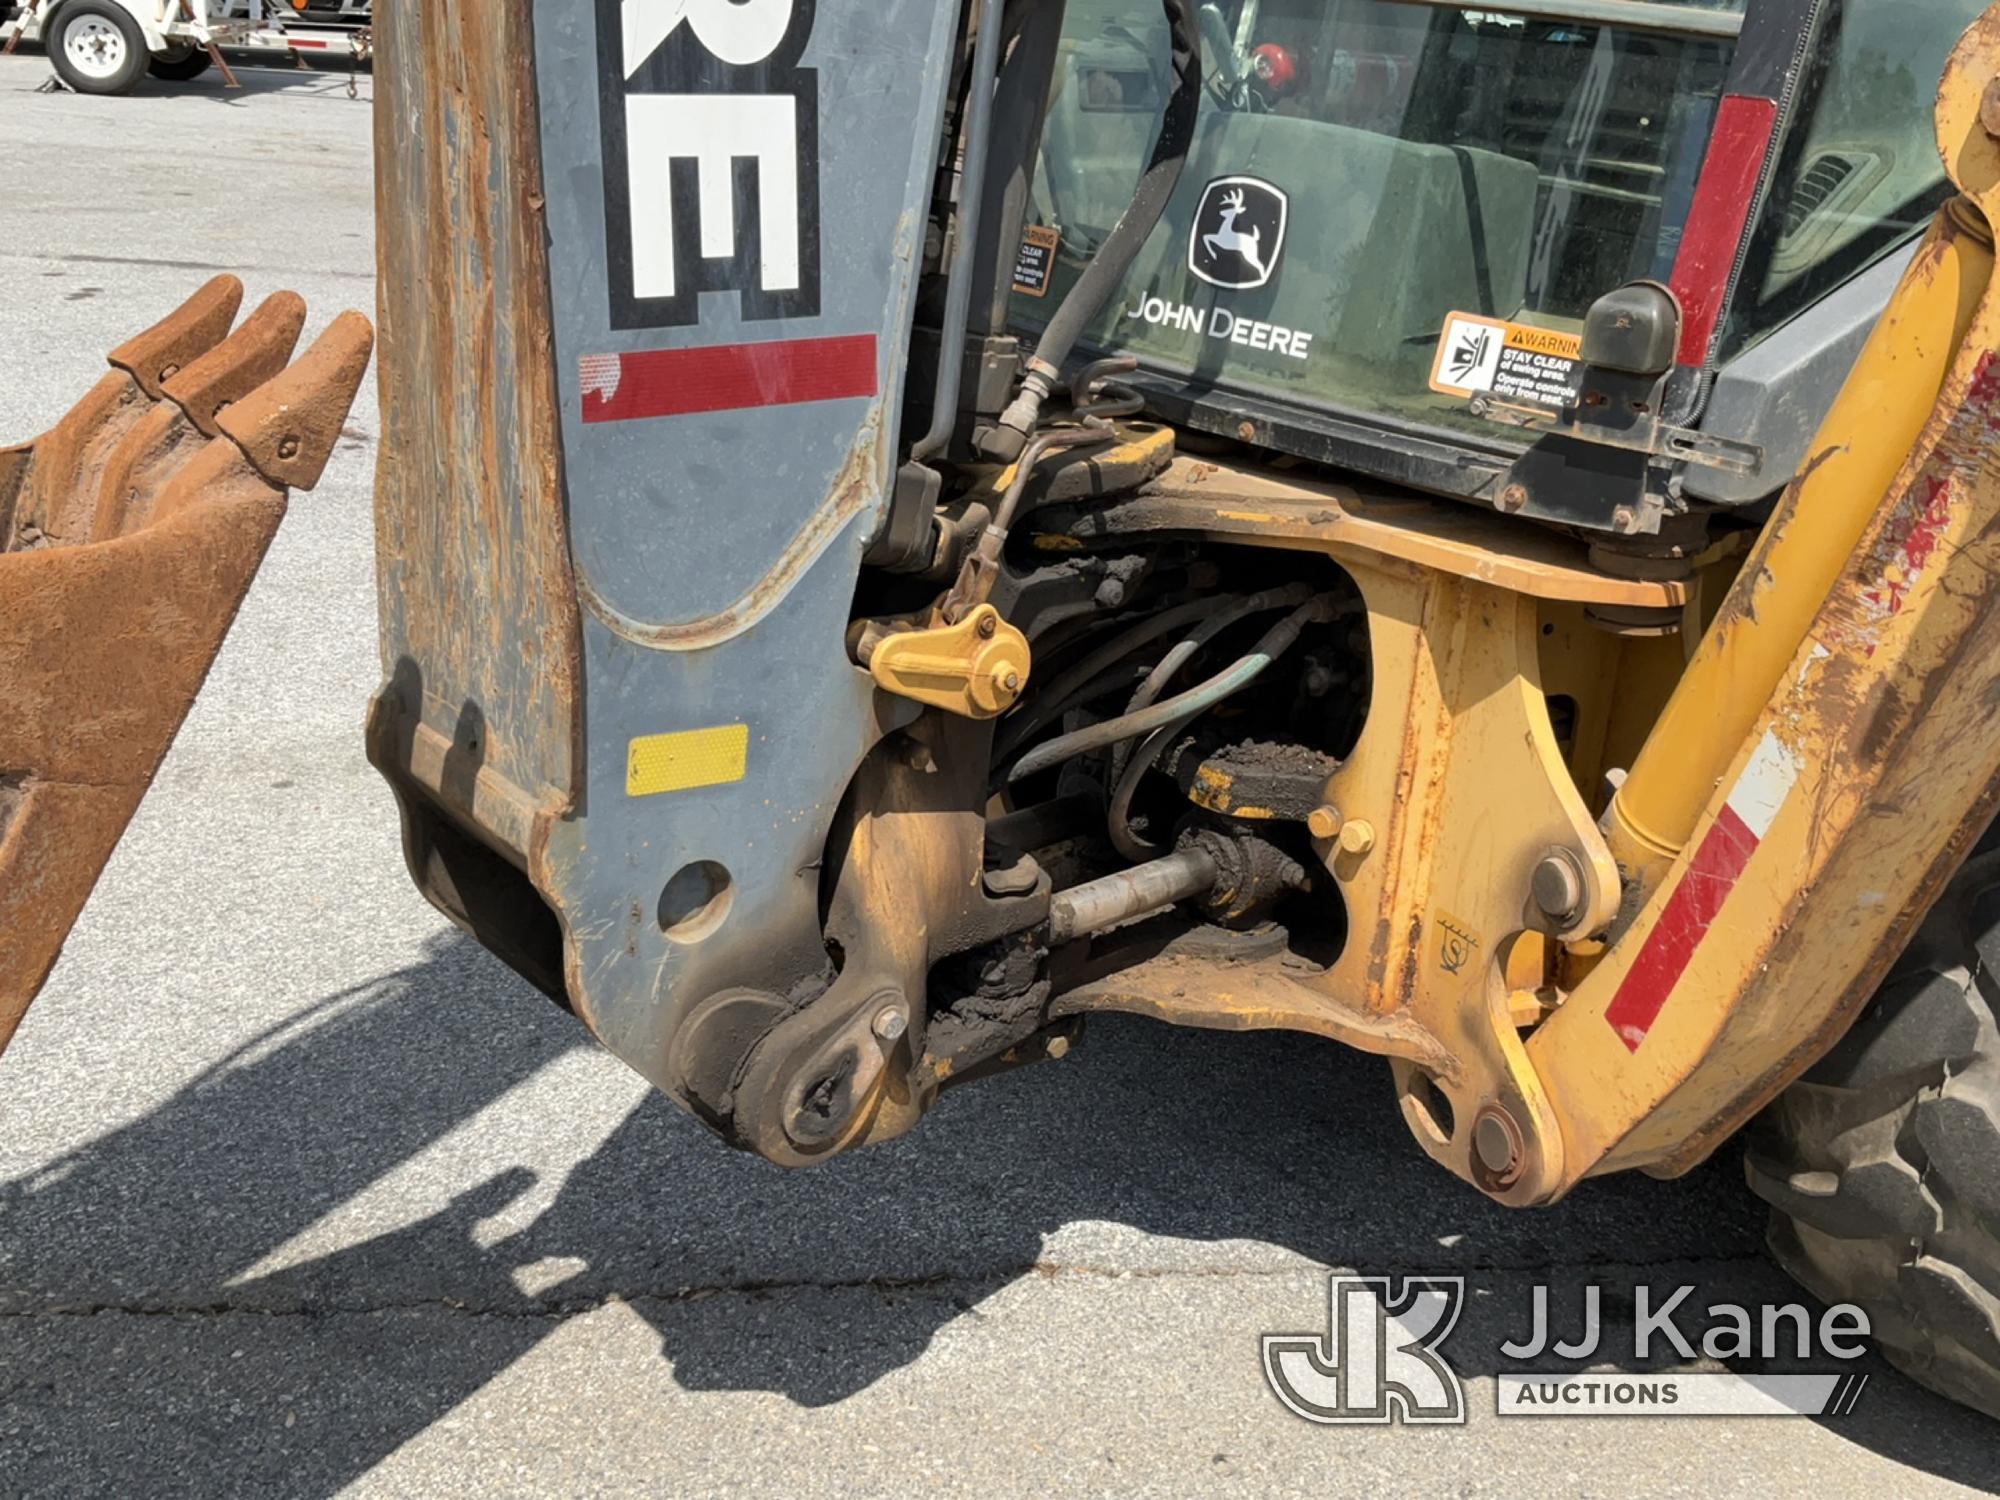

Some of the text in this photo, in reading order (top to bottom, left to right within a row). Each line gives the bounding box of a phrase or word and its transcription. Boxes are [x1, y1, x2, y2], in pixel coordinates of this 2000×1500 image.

[1128, 291, 1313, 359] JOHN DEERE
[1525, 331, 1580, 356] WARNIN
[1500, 361, 1565, 382] of swing area.
[1503, 350, 1572, 372] STAY CLEAR
[1494, 384, 1515, 397] only
[1516, 387, 1539, 401] from
[1497, 373, 1576, 398] Operate controls
